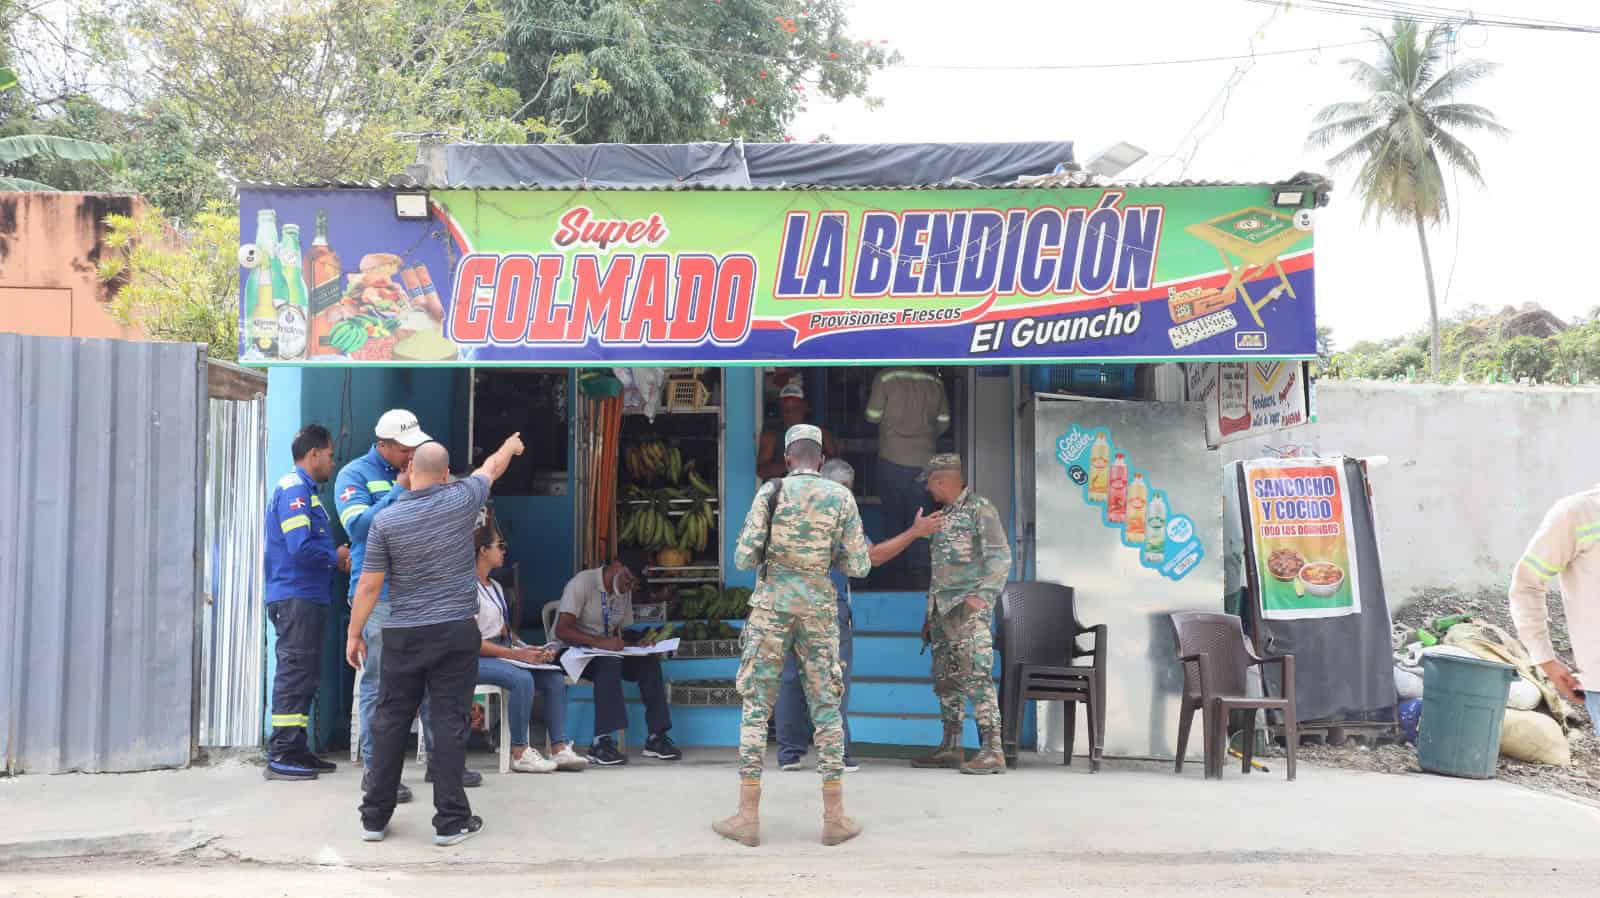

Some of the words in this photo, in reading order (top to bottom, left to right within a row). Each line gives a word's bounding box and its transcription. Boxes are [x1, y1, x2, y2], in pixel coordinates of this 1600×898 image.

[553, 206, 667, 250] Super
[776, 210, 846, 298] LA
[851, 190, 1164, 298] BENDICIÓN
[450, 252, 757, 345] COLMADO
[809, 309, 897, 329] Provisiones
[902, 307, 961, 323] Frescas
[970, 320, 1004, 354] El
[1012, 304, 1142, 348] Guancho
[1254, 477, 1335, 498] SANCOCHO
[1262, 501, 1271, 521] Y
[1275, 500, 1332, 520] COCIDO
[1260, 525, 1280, 537] TODO
[1297, 523, 1339, 536] DOMINGOS
